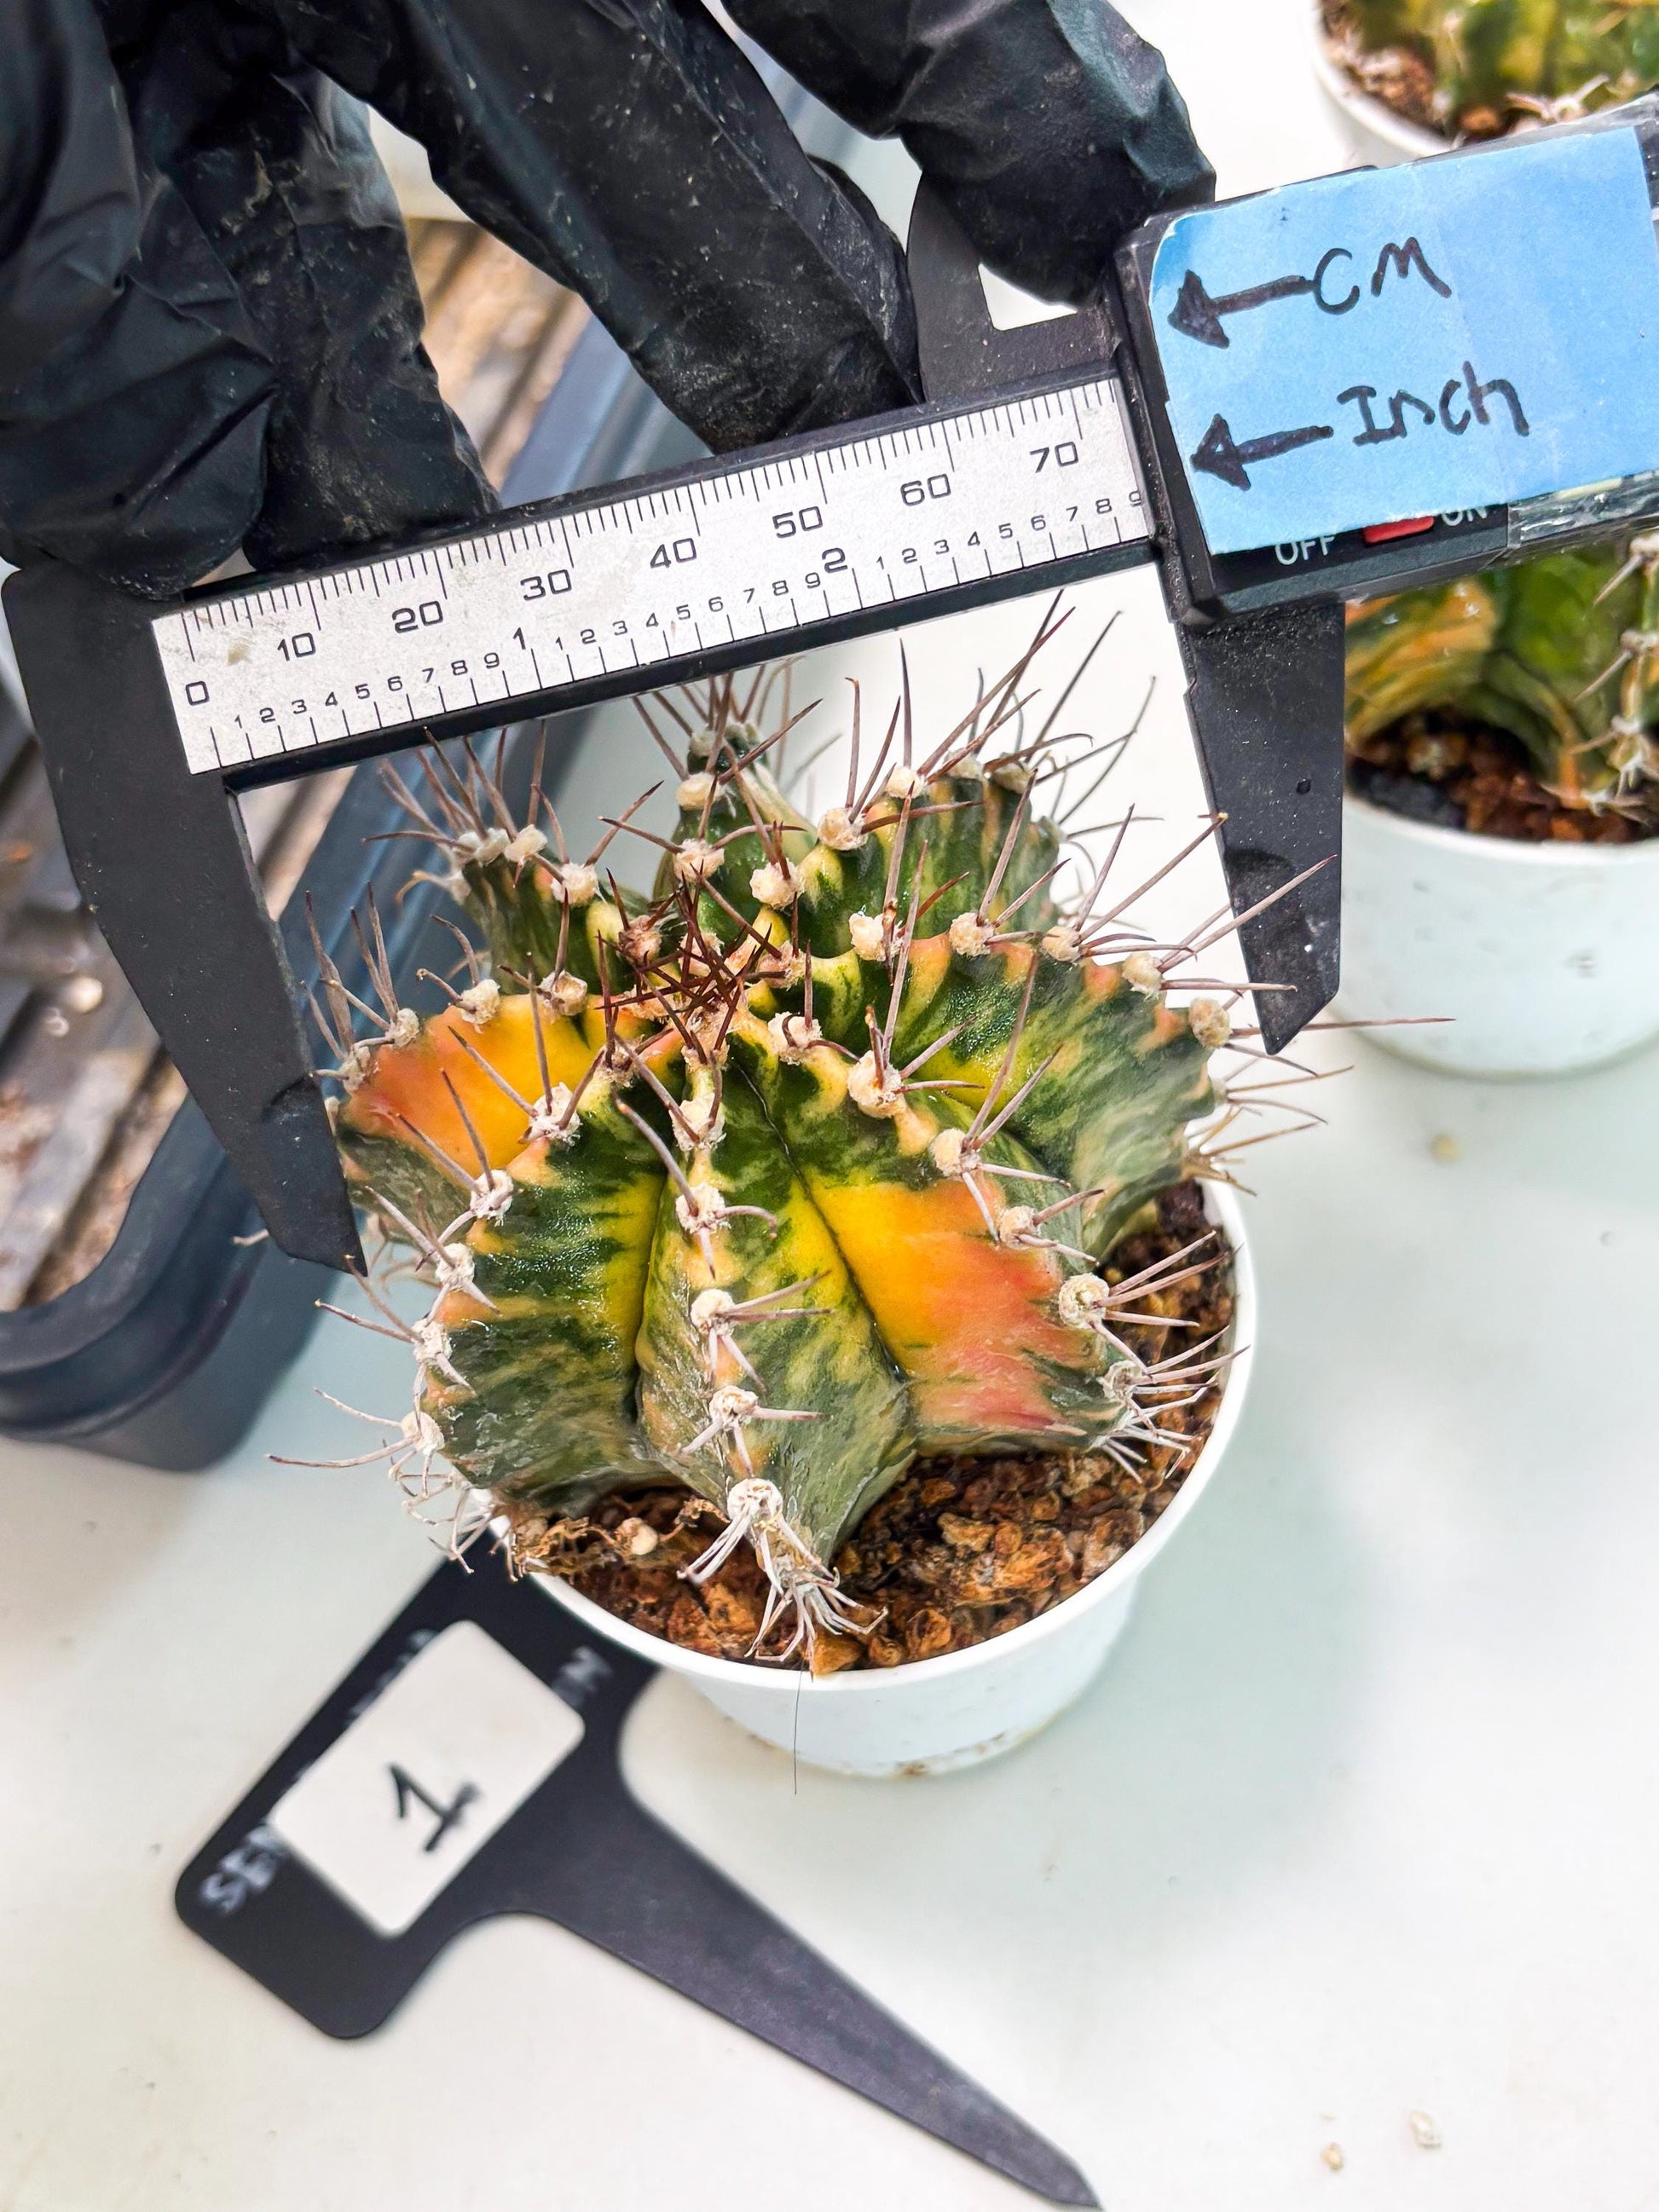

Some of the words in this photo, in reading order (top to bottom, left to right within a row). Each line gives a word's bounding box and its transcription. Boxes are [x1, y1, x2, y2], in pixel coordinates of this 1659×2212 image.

[1336, 361, 1530, 447] Inch
[185, 680, 210, 706] 0
[277, 632, 316, 661] 10
[391, 600, 443, 633] 20
[520, 569, 572, 601] 30
[650, 537, 697, 569] 40
[772, 505, 824, 539] 50
[900, 473, 951, 505] 60
[1030, 442, 1079, 472] 70
[1275, 535, 1335, 565] OFF
[234, 714, 243, 730] 1
[259, 707, 276, 724] 2
[291, 699, 307, 714] 3
[325, 691, 338, 707] 4
[355, 683, 371, 700] 5
[387, 675, 403, 692] 6
[422, 667, 436, 683] 7
[450, 659, 468, 676] 8
[483, 652, 500, 669] 9
[512, 627, 526, 650] 1
[554, 636, 564, 650] 1
[580, 628, 597, 644] 2
[612, 621, 628, 636] 3
[645, 612, 660, 628] 4
[676, 604, 691, 620] 5
[708, 596, 723, 612] 6
[743, 587, 756, 604] 7
[772, 580, 789, 596] 8
[805, 572, 821, 589] 9
[821, 547, 848, 574] 2
[876, 555, 885, 570] 1
[901, 548, 917, 564] 2
[934, 539, 950, 555] 3
[967, 530, 981, 547] 4
[997, 522, 1014, 539] 5
[1030, 515, 1047, 532] 6
[1065, 505, 1079, 522] 7
[1095, 497, 1113, 515] 8
[389, 1763, 483, 1853] 1
